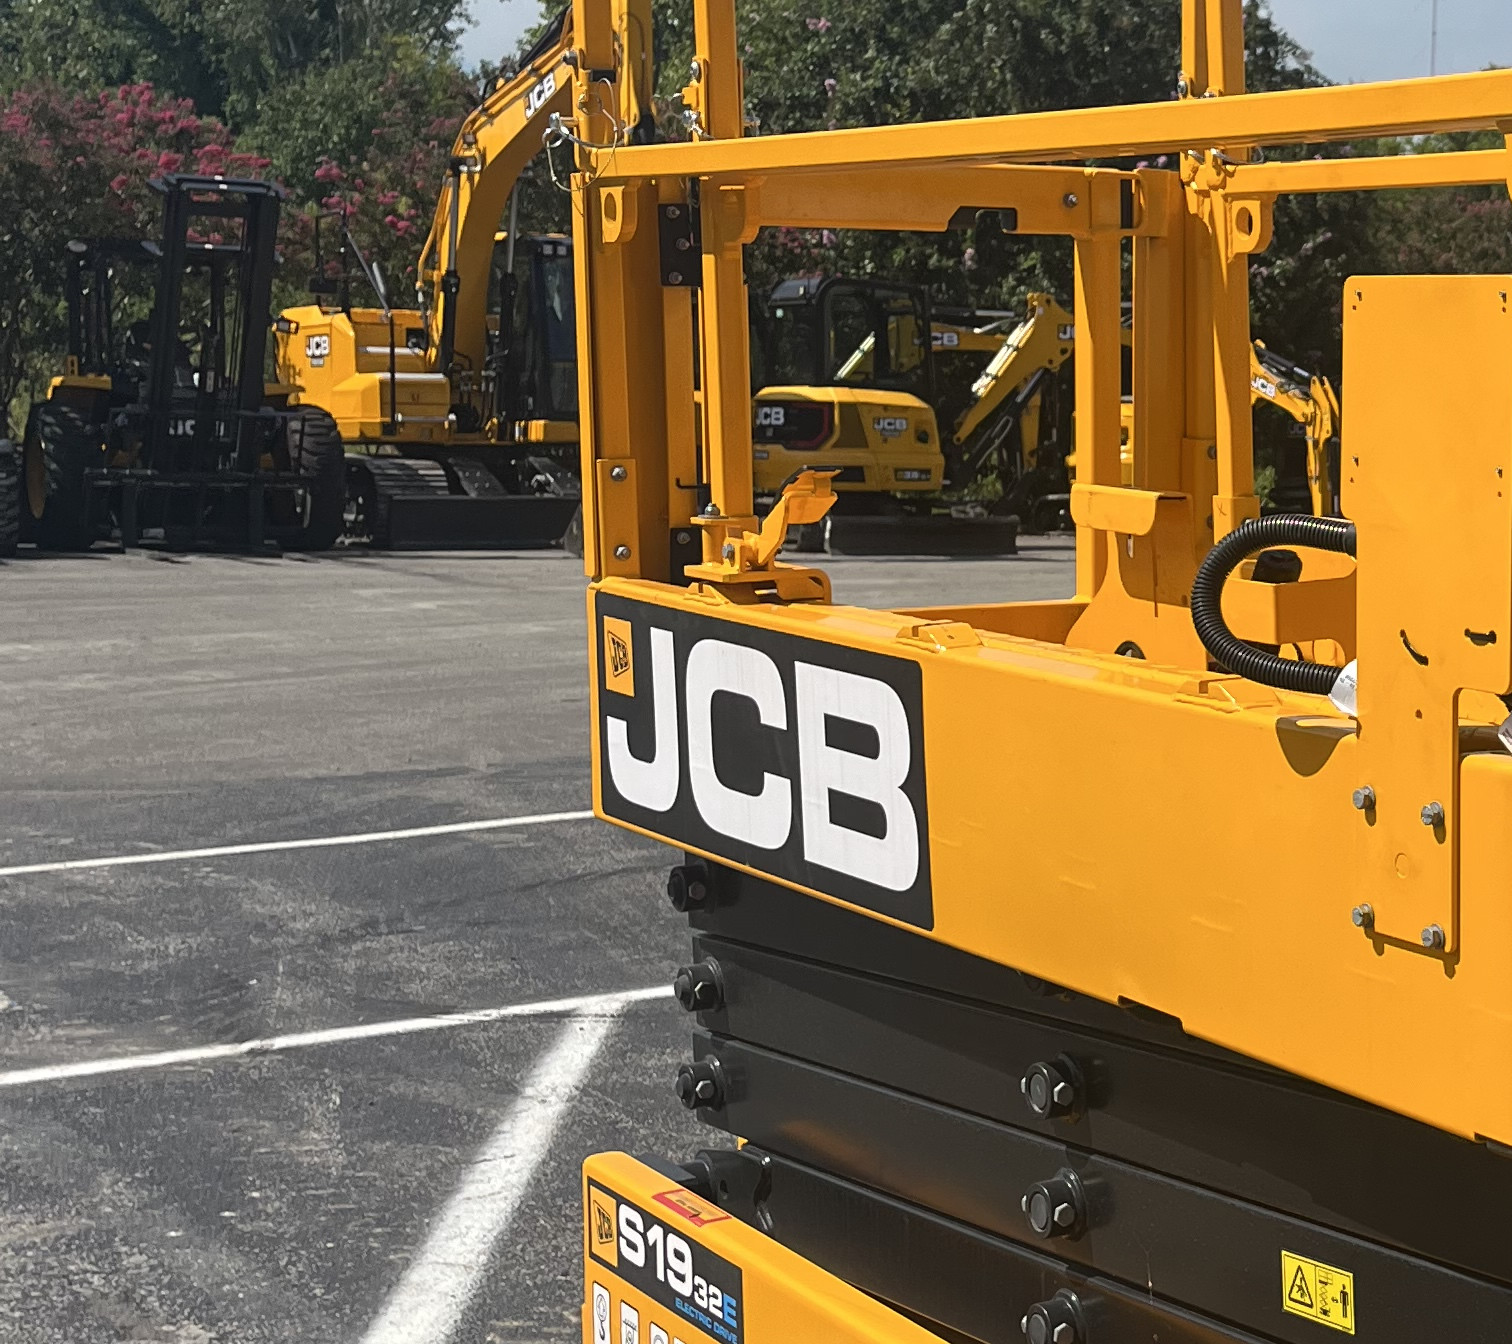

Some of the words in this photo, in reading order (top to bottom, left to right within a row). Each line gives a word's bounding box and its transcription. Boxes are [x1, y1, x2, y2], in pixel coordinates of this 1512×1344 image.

[525, 72, 556, 119] JCB
[305, 335, 330, 357] JCB
[874, 417, 907, 431] JCB
[607, 626, 919, 892] JCB
[675, 1297, 712, 1330] ELECTRIC
